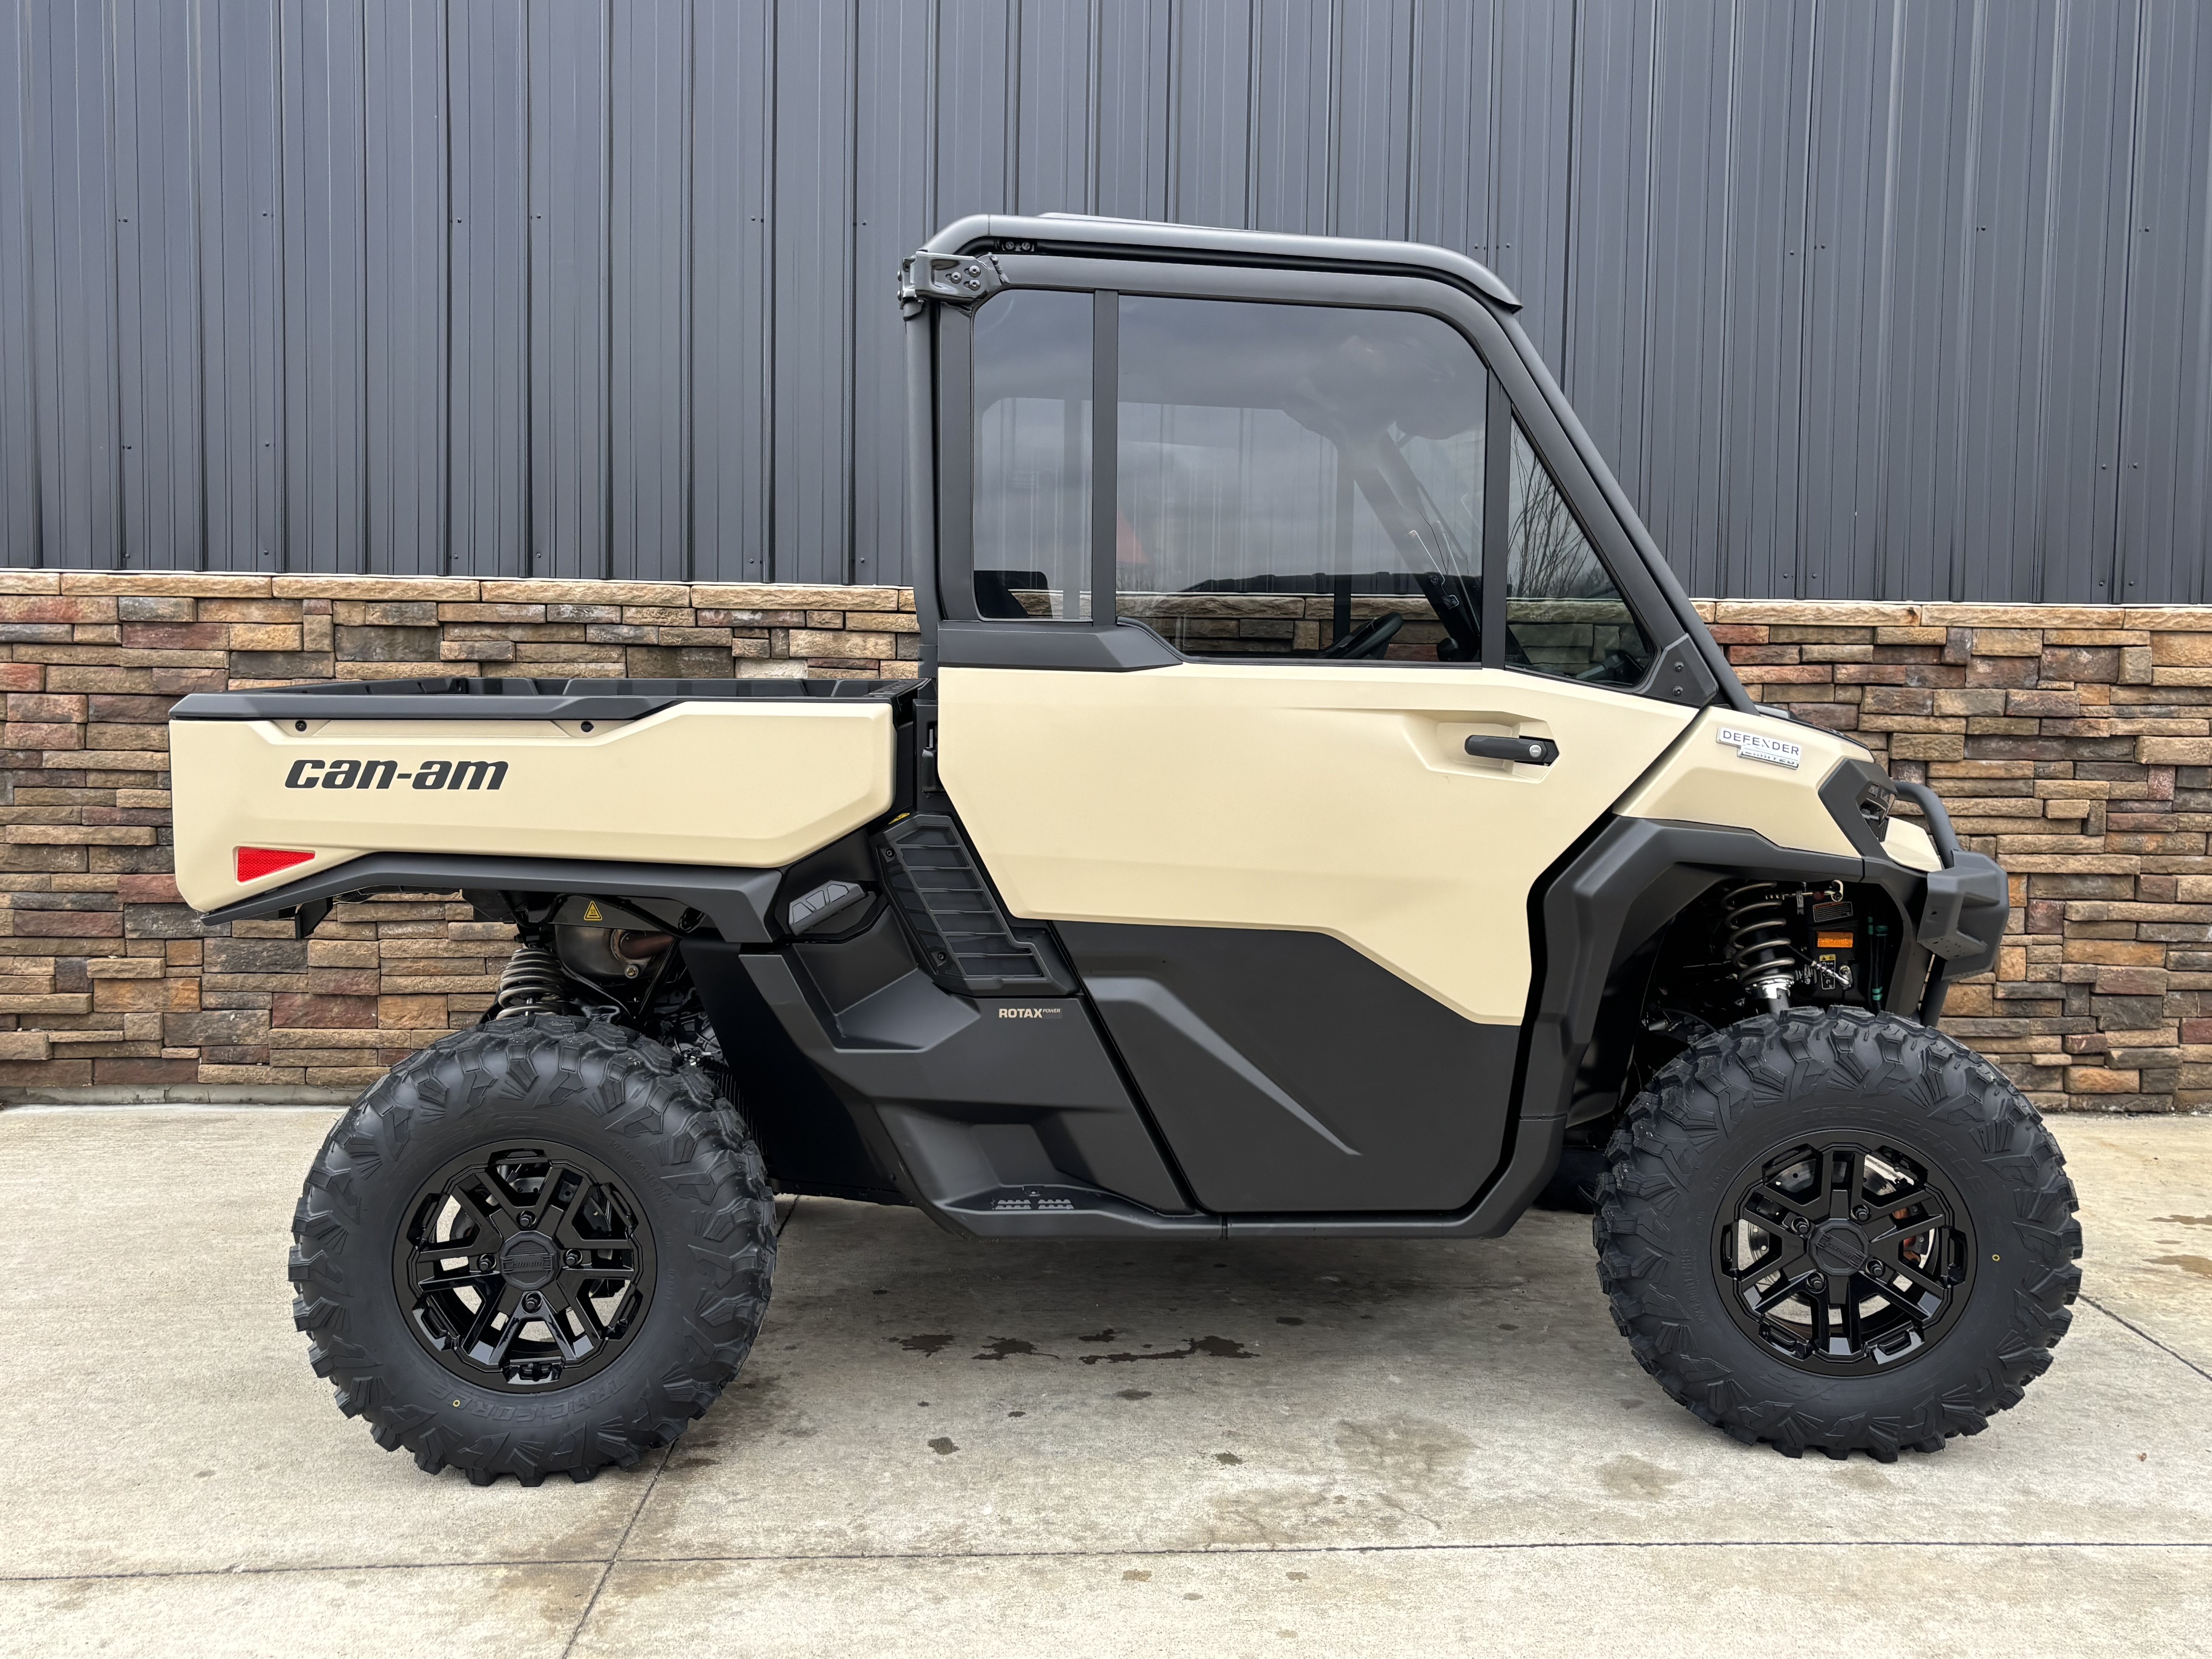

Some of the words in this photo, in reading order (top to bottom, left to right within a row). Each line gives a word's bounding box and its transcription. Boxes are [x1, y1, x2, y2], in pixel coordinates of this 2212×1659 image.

[1723, 730, 1799, 755] DEFENDER
[285, 759, 508, 790] can-am
[999, 1008, 1042, 1018] ROTAX
[427, 1379, 538, 1422] FORCE
[548, 1372, 629, 1419] TRAC
